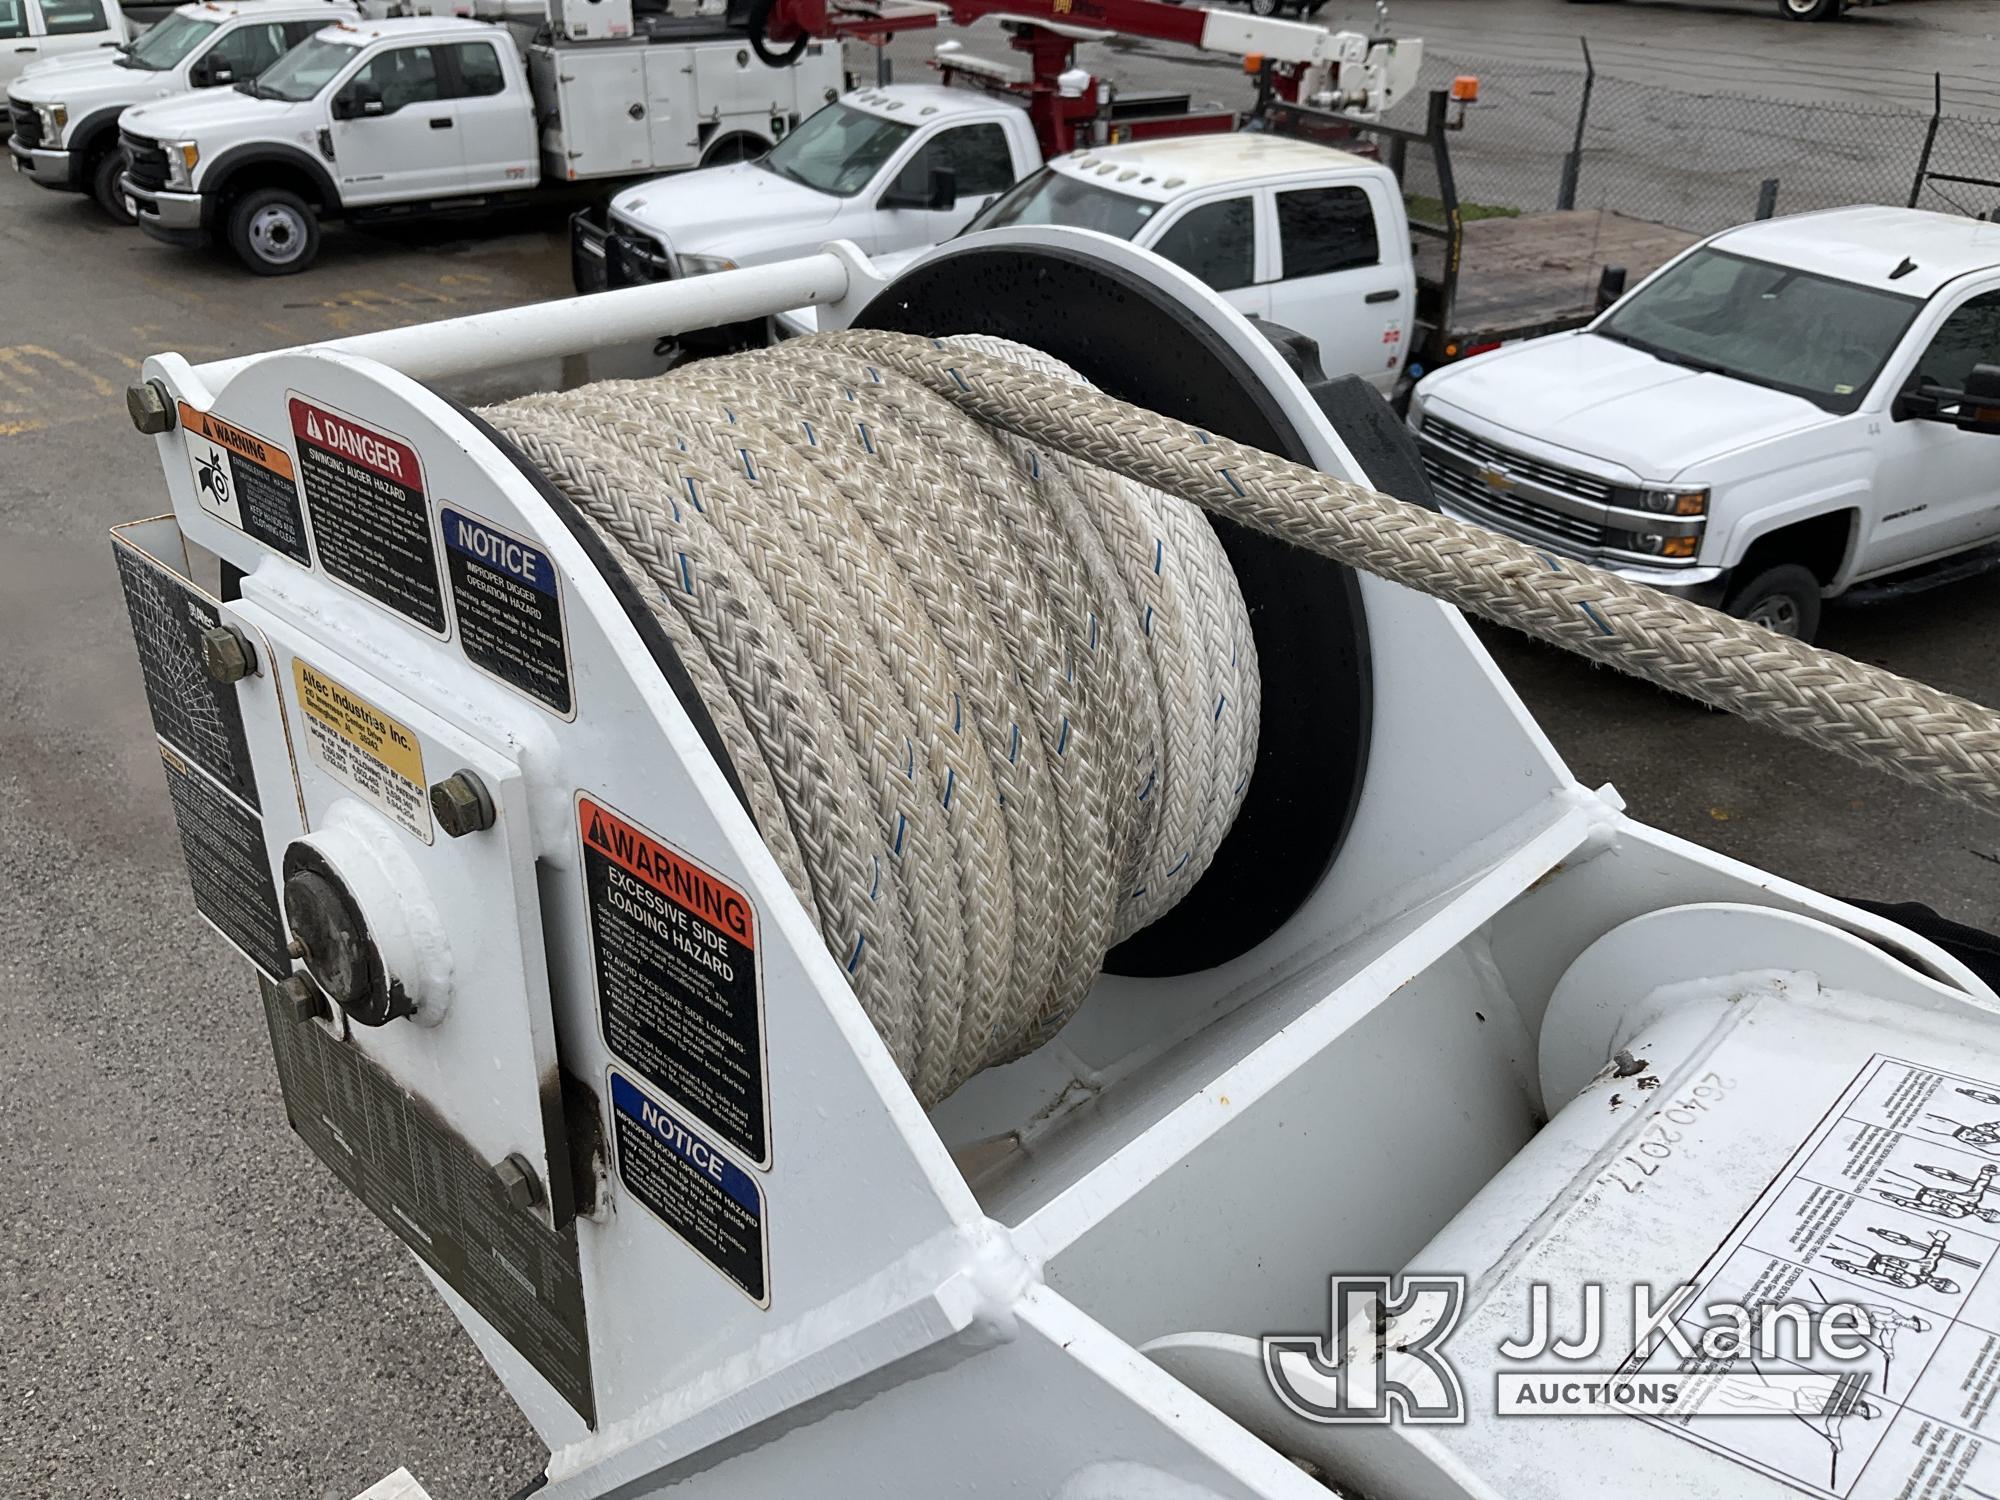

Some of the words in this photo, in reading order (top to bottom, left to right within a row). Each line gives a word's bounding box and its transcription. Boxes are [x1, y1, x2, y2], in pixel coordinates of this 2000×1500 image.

[213, 422, 266, 462] WARNING
[309, 448, 345, 473] SWINGING
[347, 465, 372, 486] AUGER
[373, 478, 406, 501] HAZARD
[325, 420, 402, 476] DANGER
[252, 515, 279, 536] CLOTHING
[279, 530, 297, 546] CLEAR
[459, 521, 536, 581] NOTICE
[466, 561, 505, 587] IMPROPER
[506, 580, 536, 603] DIGGER
[466, 574, 508, 603] OPERATION
[509, 596, 542, 620] HAZARD
[303, 668, 329, 697] Altec
[331, 687, 386, 735] Industries
[389, 724, 411, 751] Inc.
[609, 866, 687, 930] EXCESSIVE
[692, 921, 728, 957] SIDE
[611, 825, 746, 936] WARNING
[607, 886, 668, 940] LOADING
[673, 930, 733, 981] HAZARD
[601, 947, 613, 960] TO
[614, 956, 637, 977] AVOID
[638, 973, 682, 1010] EXCESSIVE
[684, 1005, 704, 1025] SIDE
[616, 1108, 652, 1142] IMPROPER
[654, 1139, 677, 1163] BOOM
[679, 1160, 722, 1199] OPERATION
[724, 1196, 758, 1227] HAZARD
[642, 1102, 723, 1180] NOTICE
